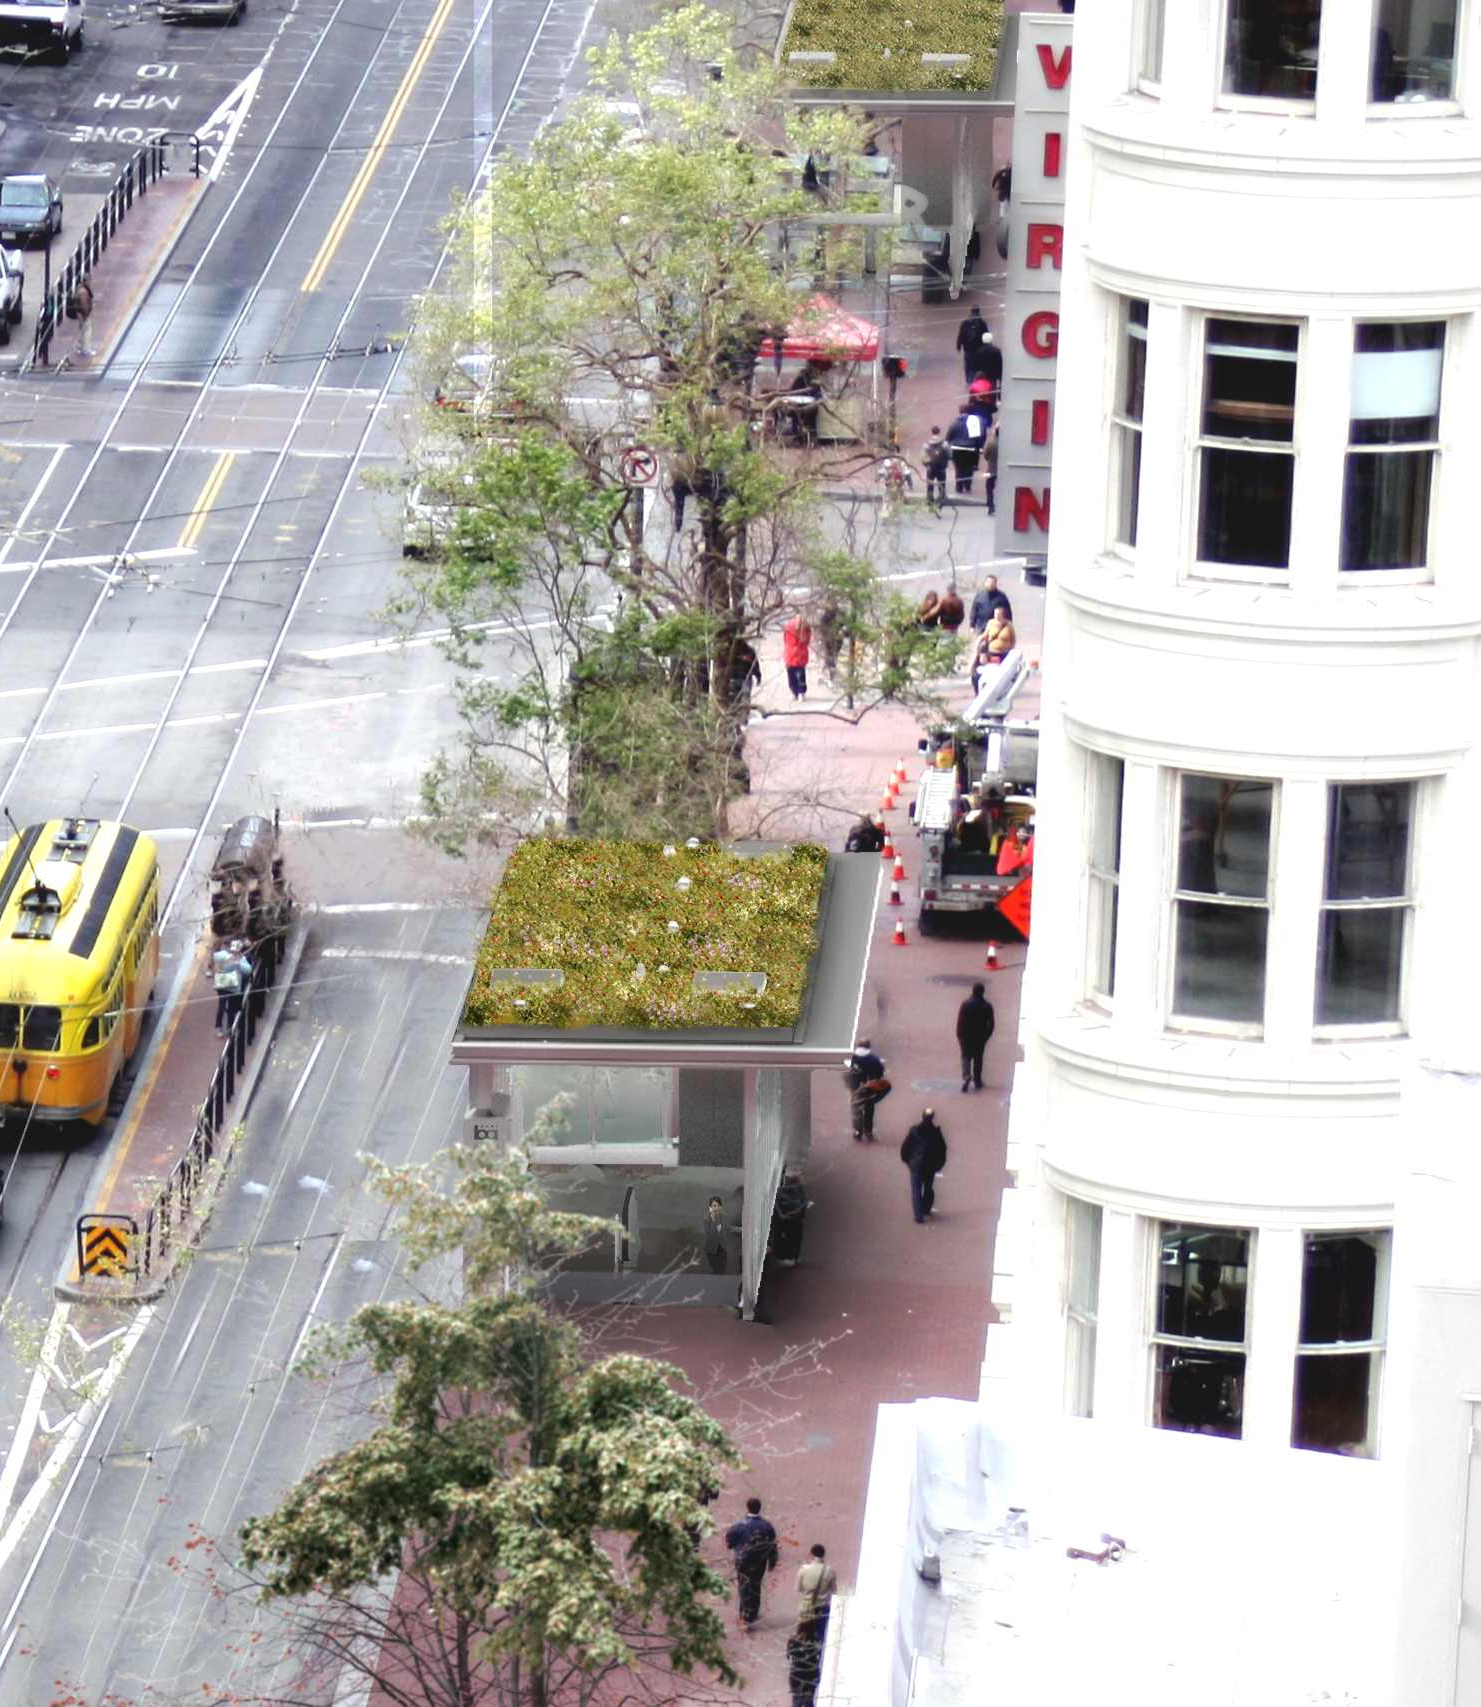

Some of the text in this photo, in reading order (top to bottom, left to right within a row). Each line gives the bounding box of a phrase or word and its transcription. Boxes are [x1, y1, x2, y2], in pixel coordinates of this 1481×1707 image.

[136, 63, 179, 79] 10
[93, 92, 181, 110] MPH
[69, 125, 170, 147] ZONE
[1013, 44, 1072, 532] VIRGIN
